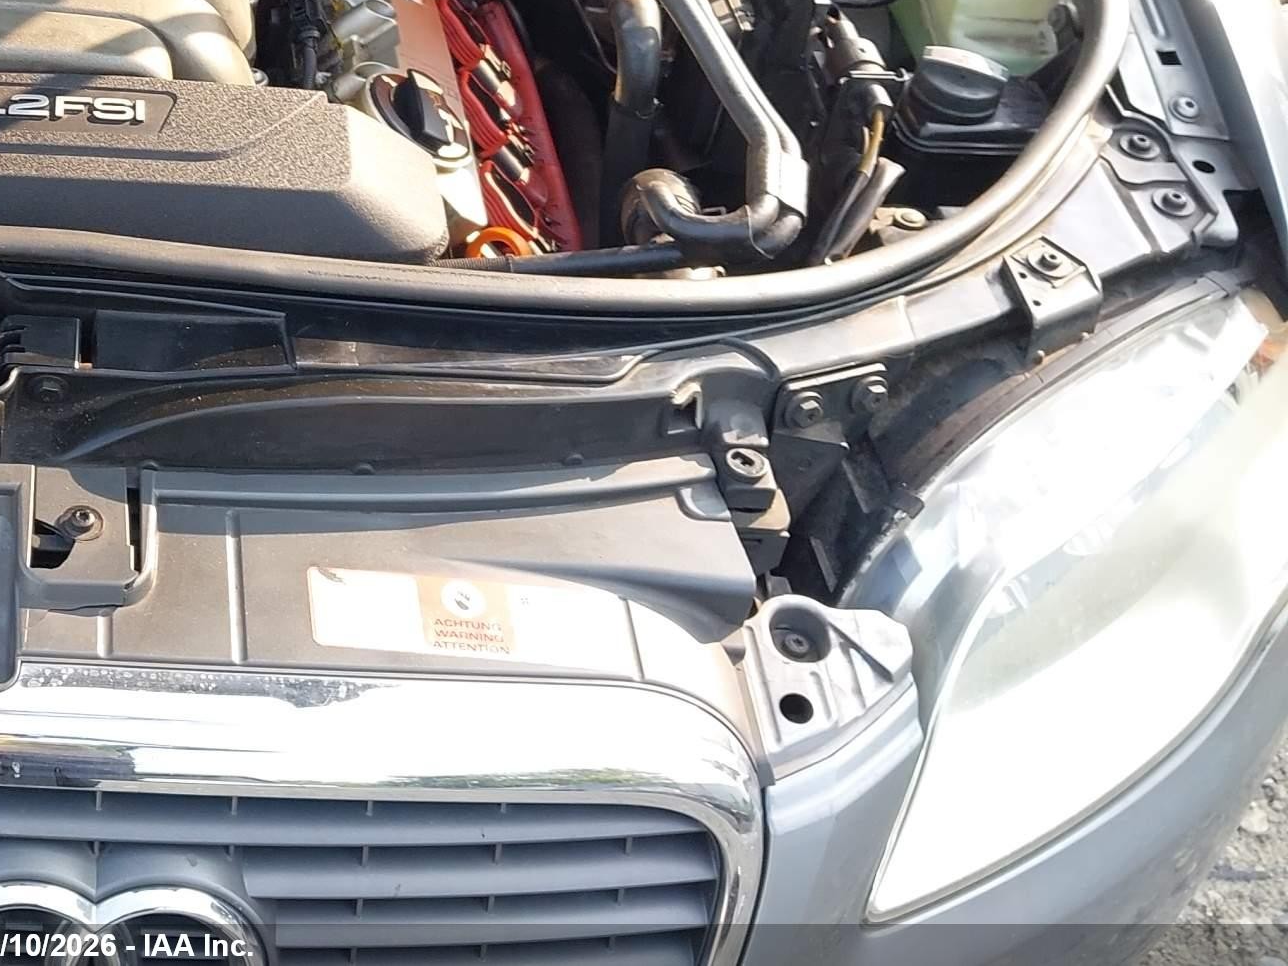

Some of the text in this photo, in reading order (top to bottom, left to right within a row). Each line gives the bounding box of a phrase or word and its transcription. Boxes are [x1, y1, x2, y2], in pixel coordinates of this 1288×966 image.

[434, 619, 503, 631] ACHTUNG
[434, 629, 505, 643] WARNING
[433, 641, 510, 654] ATTENTION
